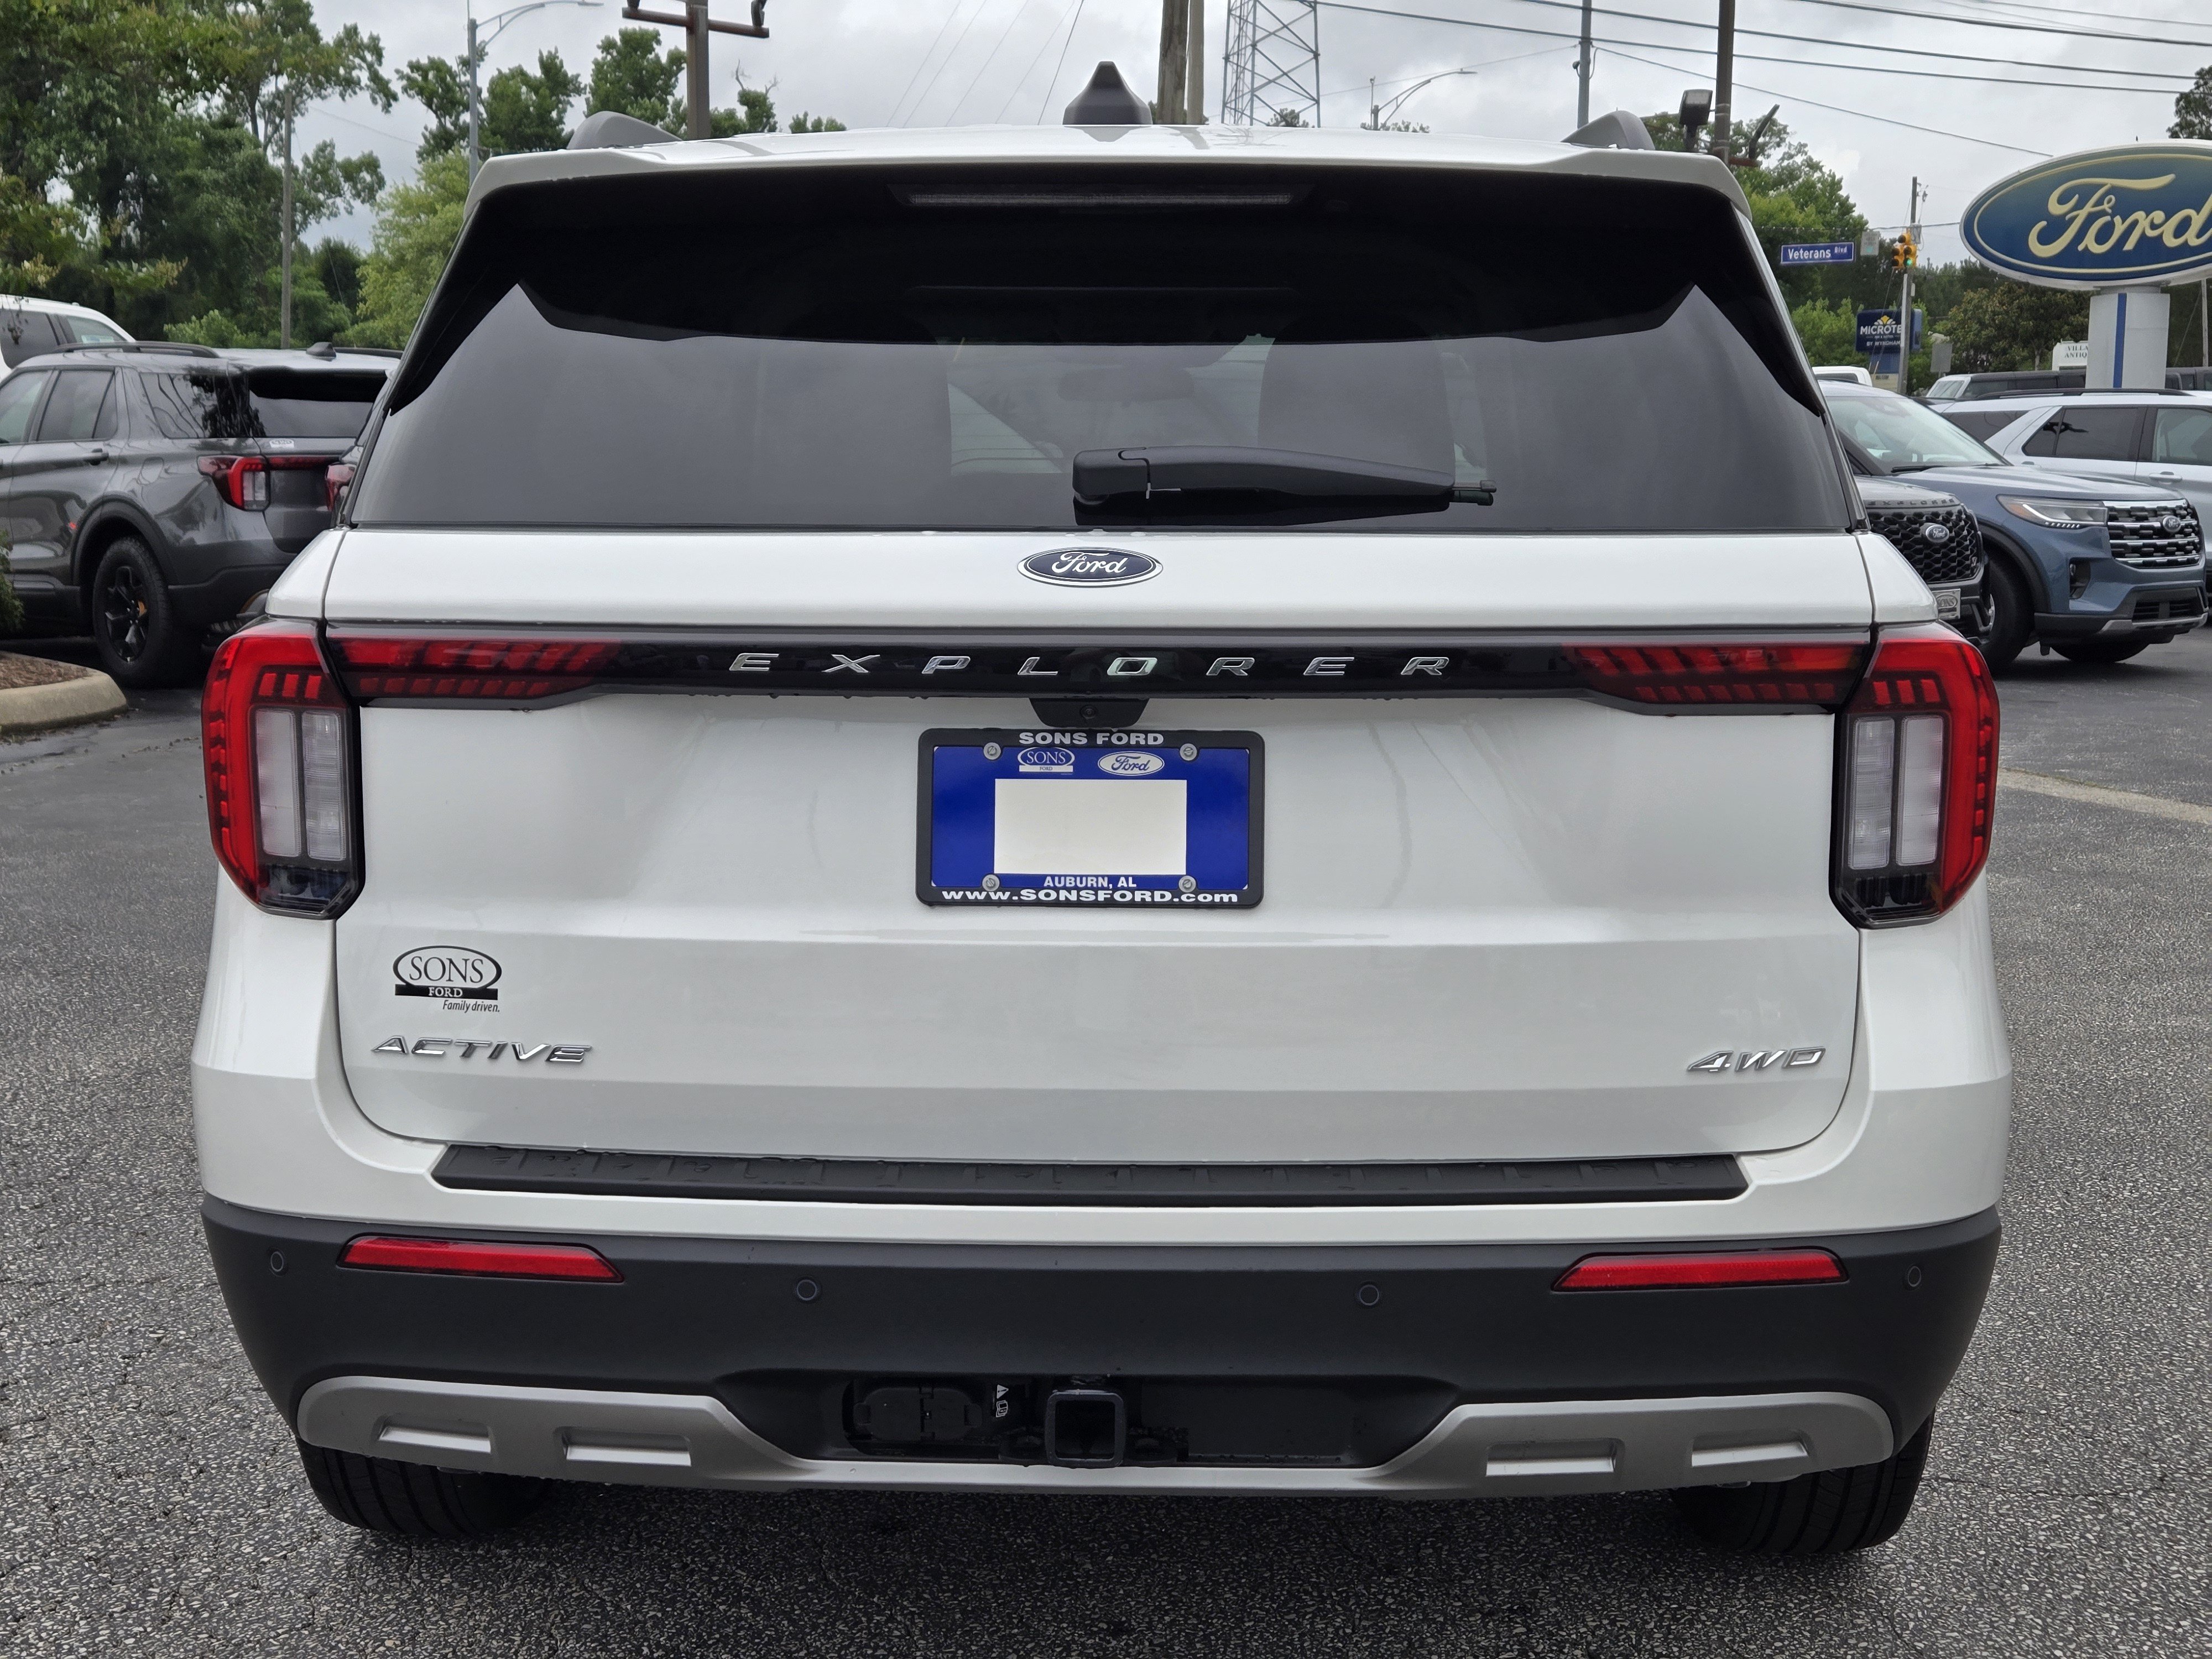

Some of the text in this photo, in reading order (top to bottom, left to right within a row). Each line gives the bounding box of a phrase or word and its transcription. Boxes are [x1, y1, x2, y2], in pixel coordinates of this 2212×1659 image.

[2028, 173, 2212, 258] Ford
[1788, 247, 1832, 260] Veterans
[1051, 551, 1129, 573] Ford
[728, 653, 1451, 677] EXPLORER
[1019, 732, 1164, 745] SONS FORD
[1026, 751, 1066, 764] SONS
[1111, 755, 1151, 771] Ford
[1044, 877, 1137, 888] AUBURN, AL
[942, 889, 1238, 904] www.SONSFORD.com
[409, 956, 484, 984] SONS
[428, 987, 463, 998] FORD
[442, 1000, 500, 1013] Family driven.
[371, 1035, 594, 1063] ACTIVE
[1687, 1046, 1826, 1072] 4WD
